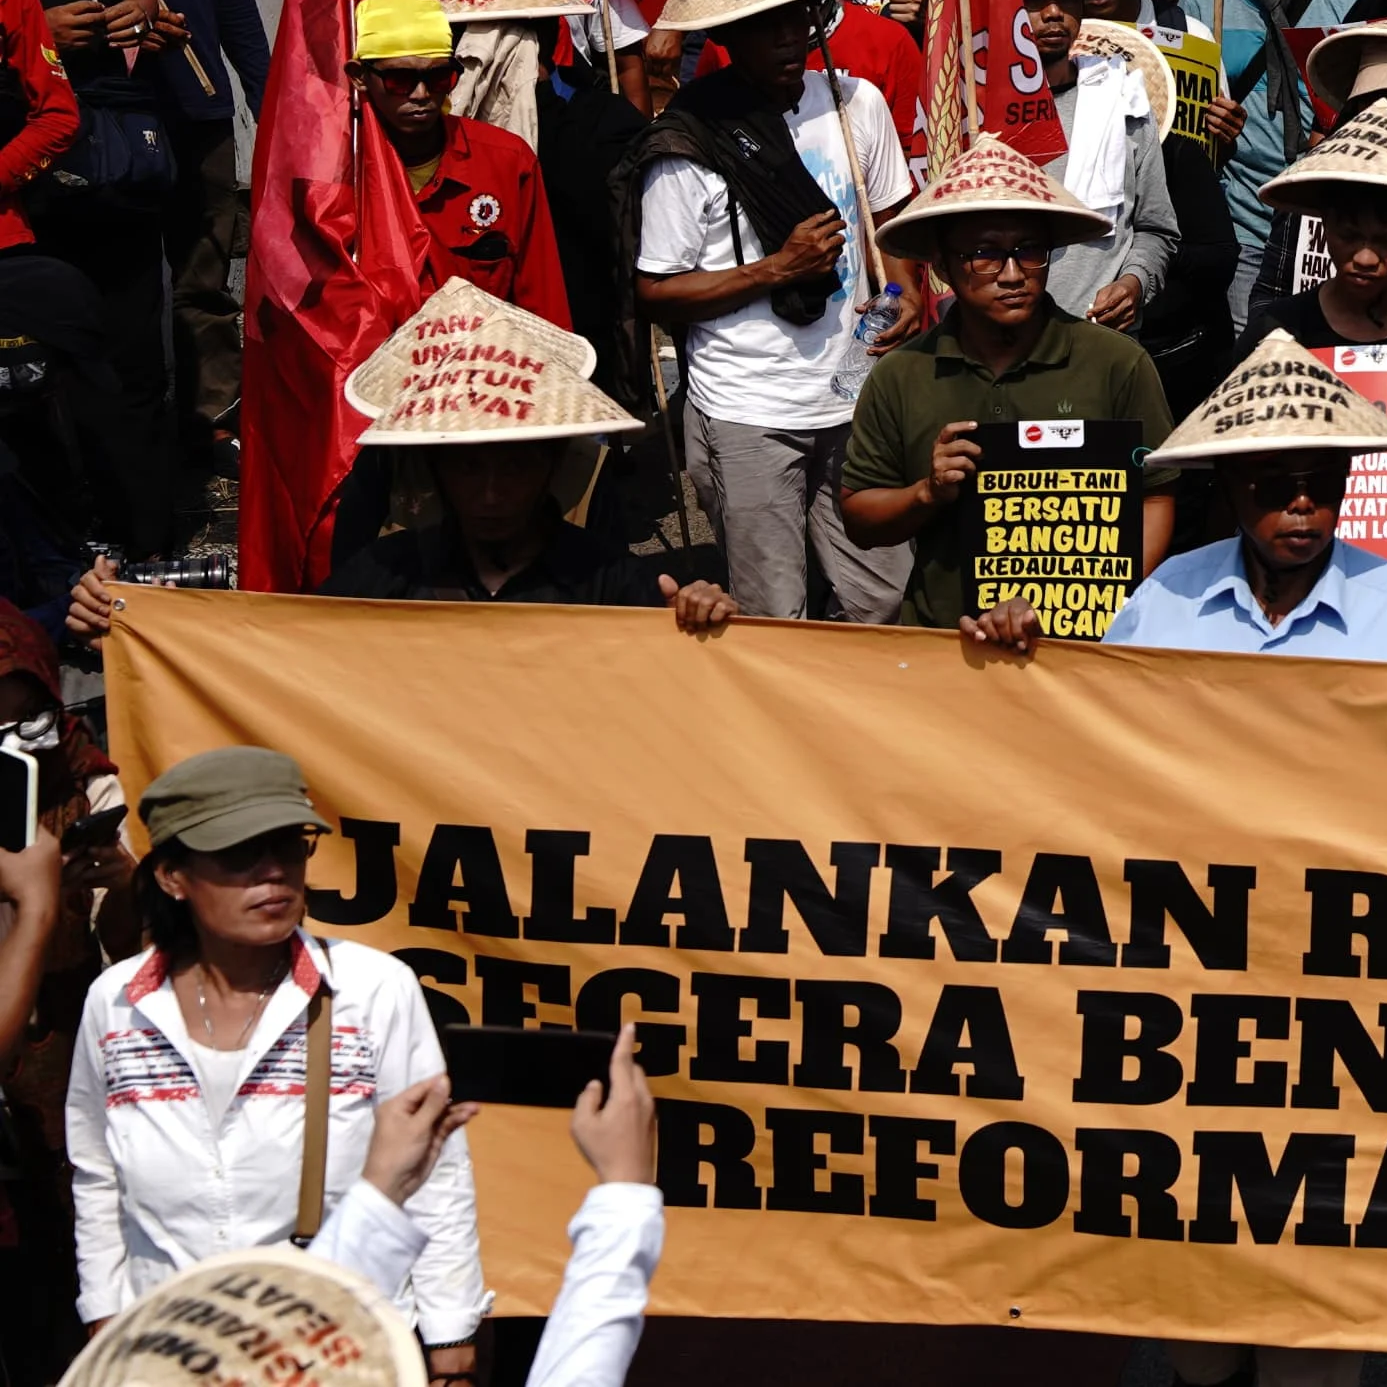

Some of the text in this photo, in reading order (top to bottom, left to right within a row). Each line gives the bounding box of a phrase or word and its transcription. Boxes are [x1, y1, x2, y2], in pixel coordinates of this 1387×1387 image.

[1214, 404, 1334, 434] SEJATI
[983, 472, 1120, 490] BURUH-TANI
[984, 497, 1121, 523] BERSATU
[986, 525, 1119, 553] BANGUN
[979, 557, 1129, 577] KEDAULATAN
[308, 816, 1256, 970] JALANKAN
